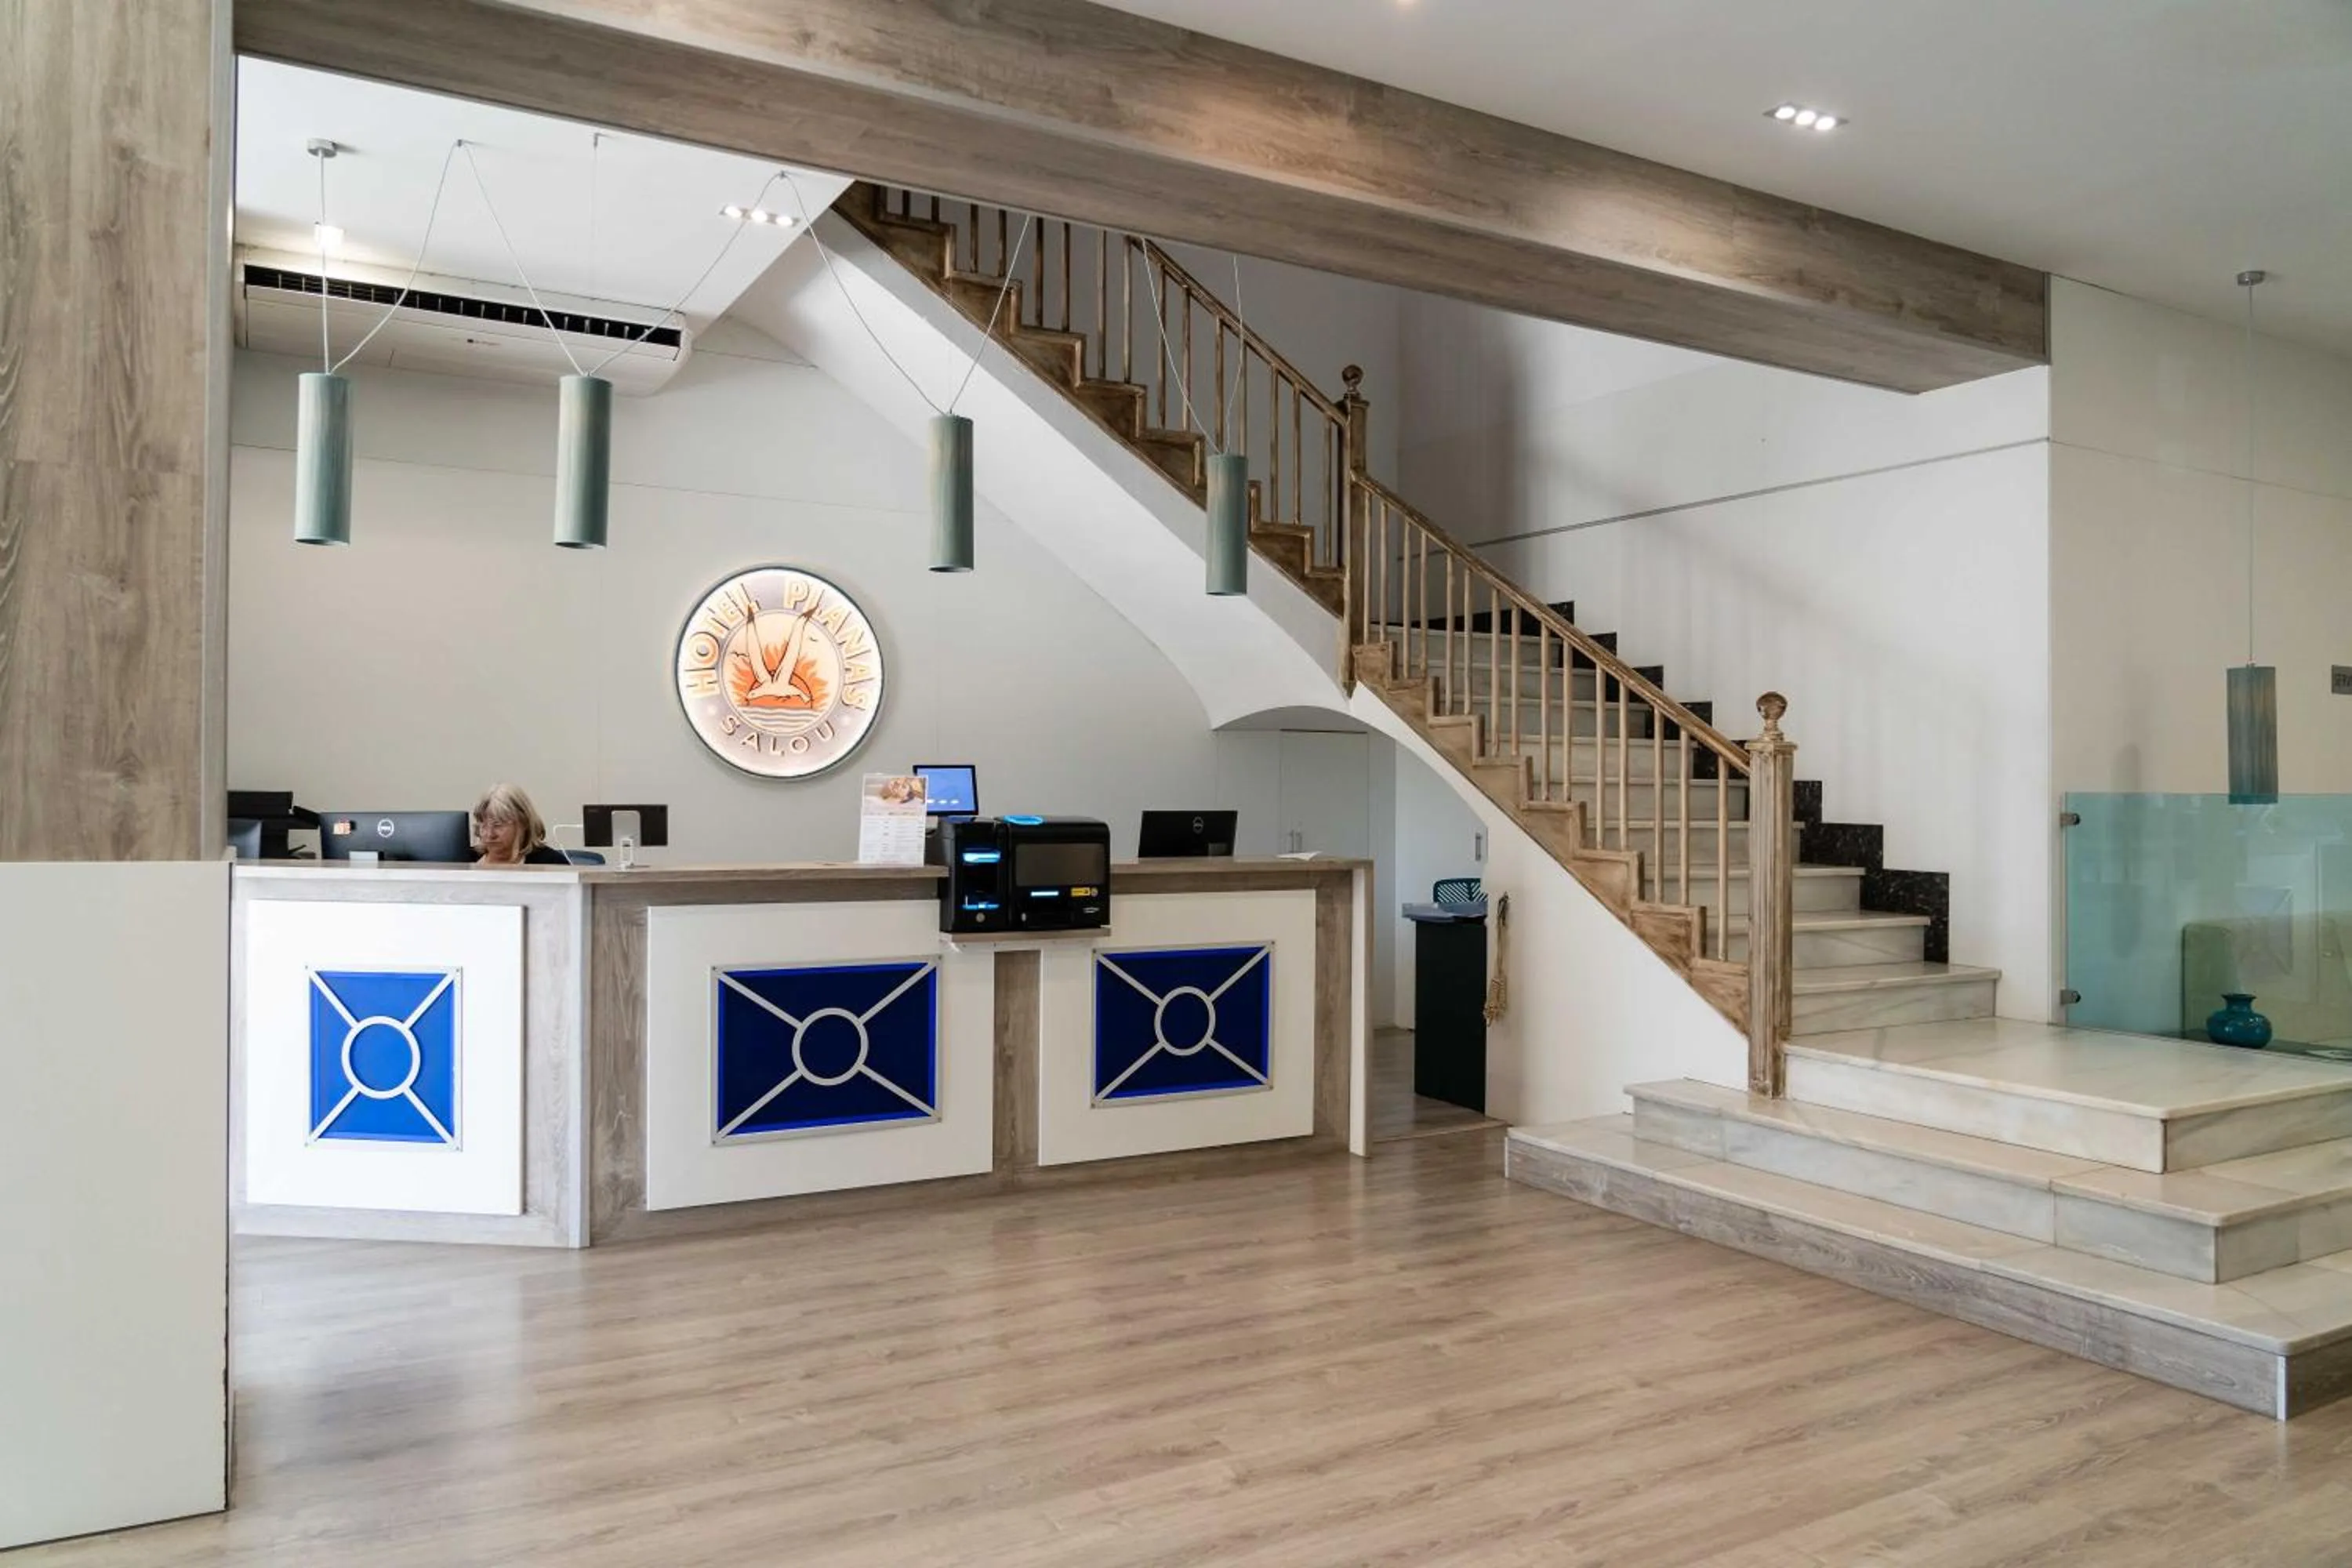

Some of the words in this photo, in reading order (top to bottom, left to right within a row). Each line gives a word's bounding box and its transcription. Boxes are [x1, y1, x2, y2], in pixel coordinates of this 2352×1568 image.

[684, 583, 762, 699] HOTEL
[784, 579, 874, 711] PLANAS
[721, 716, 836, 756] SALOU
